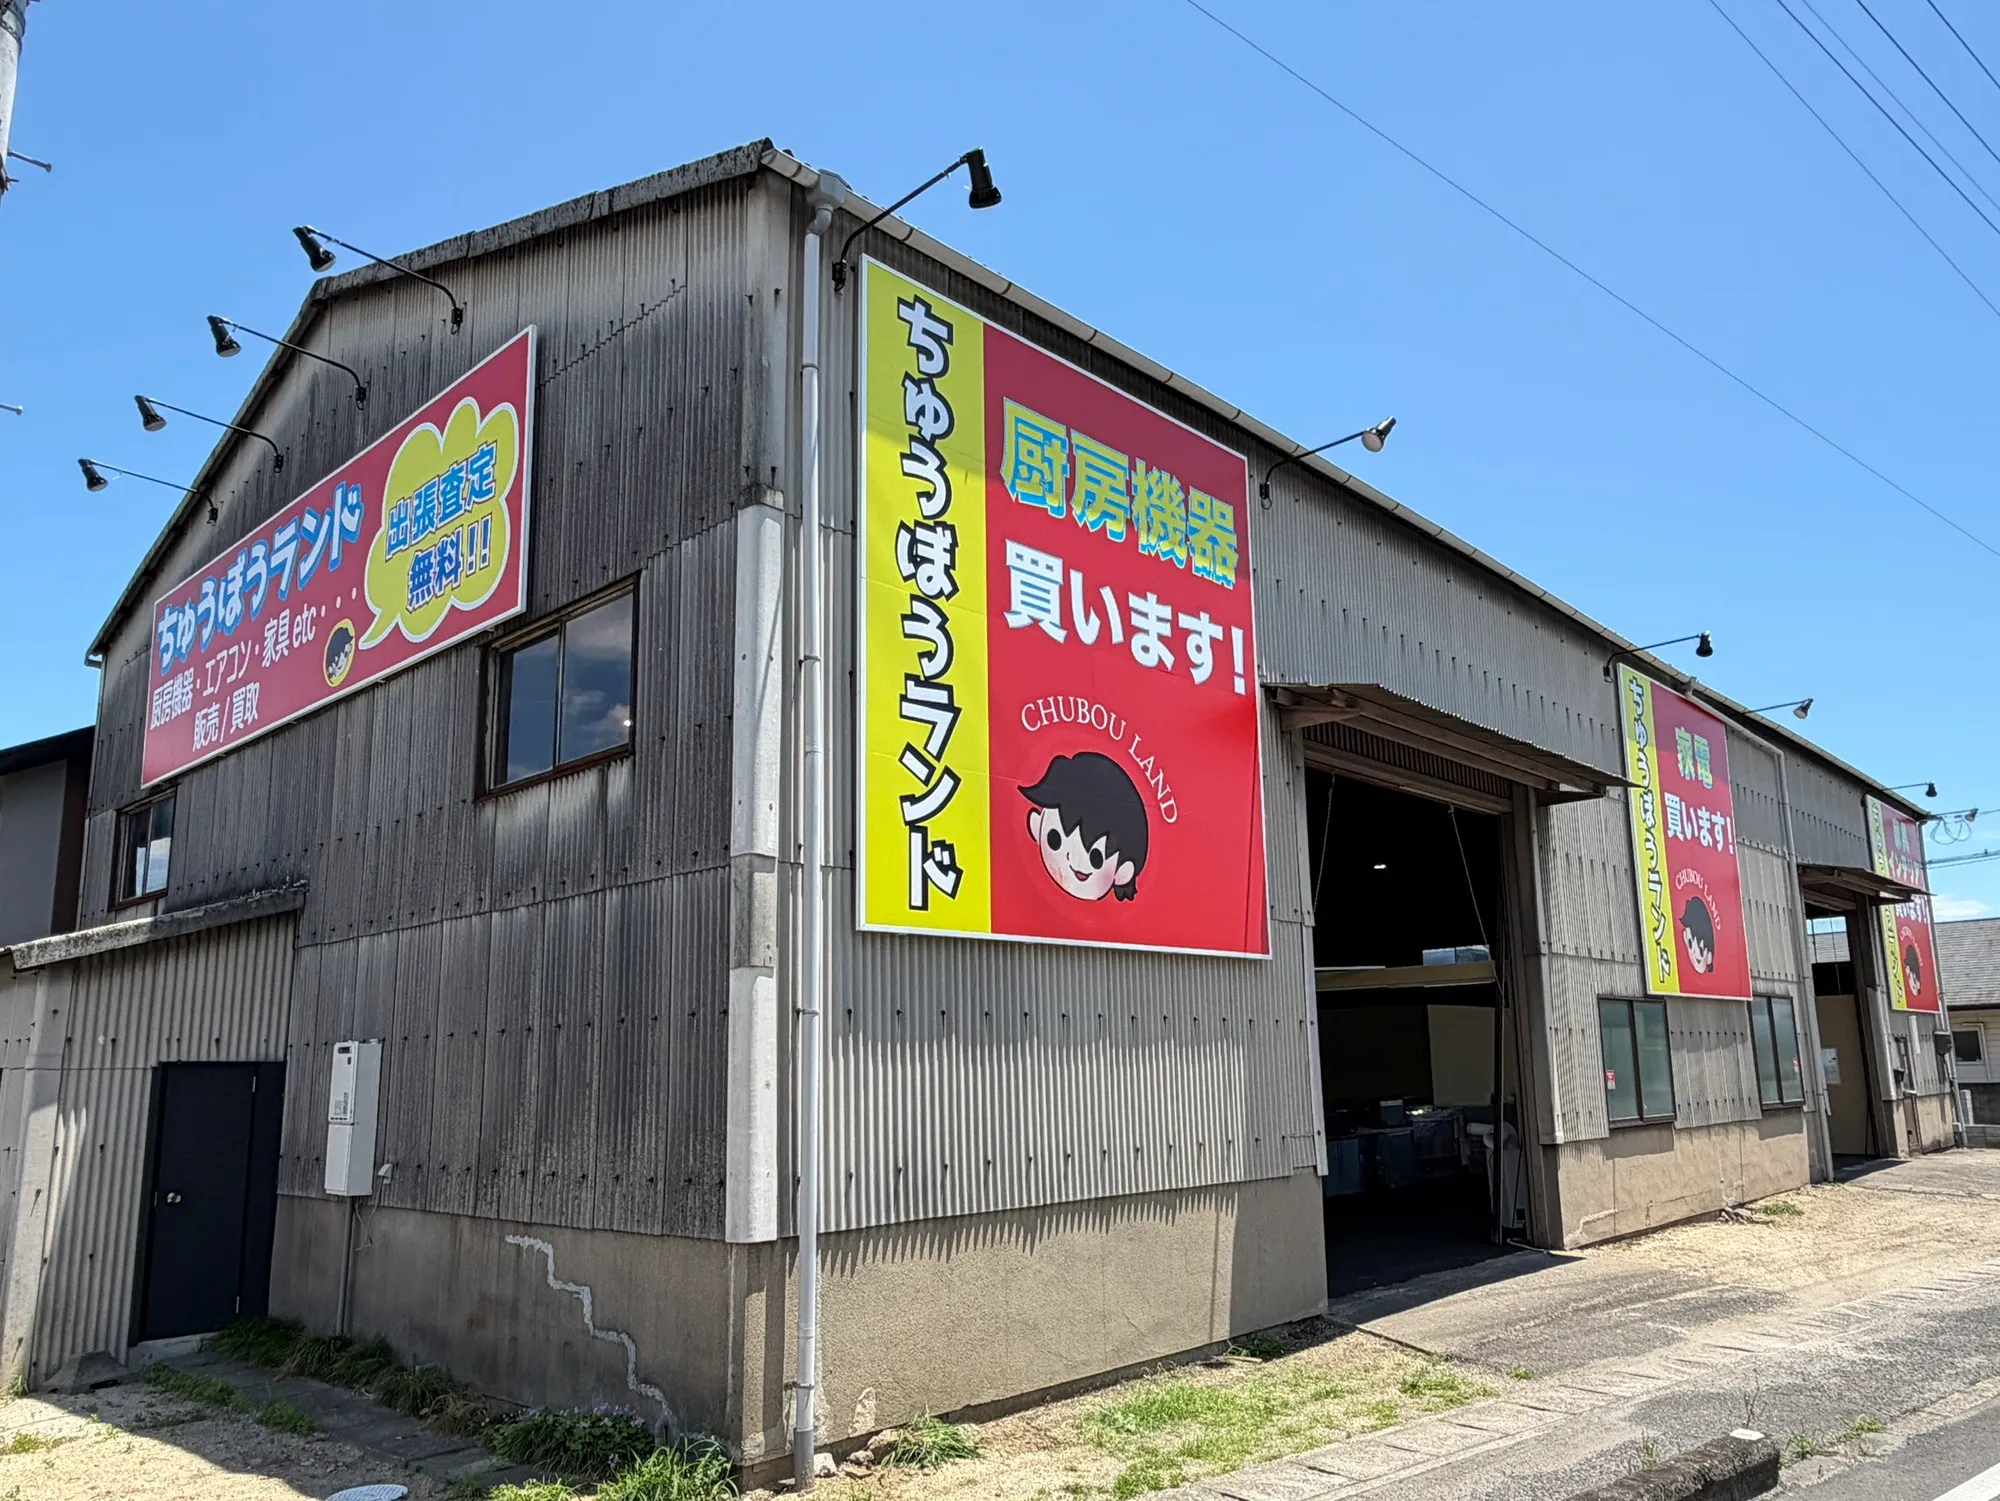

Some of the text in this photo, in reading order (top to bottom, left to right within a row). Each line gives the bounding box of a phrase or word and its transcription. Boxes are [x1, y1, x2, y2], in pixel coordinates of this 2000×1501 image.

[385, 440, 497, 562] 出張査定
[1001, 396, 1239, 591] 厨房機器
[158, 481, 364, 676] ちゅうぼうランド
[406, 513, 493, 614] 無料!!
[894, 294, 963, 912] ちゅうぼうランド
[1003, 538, 1246, 696] 買います!
[1021, 696, 1178, 824] CHUBOU LAND
[1675, 726, 1713, 789] 家電
[1664, 787, 1734, 855] 買います!
[1676, 868, 1721, 931] CHUBOU LAND
